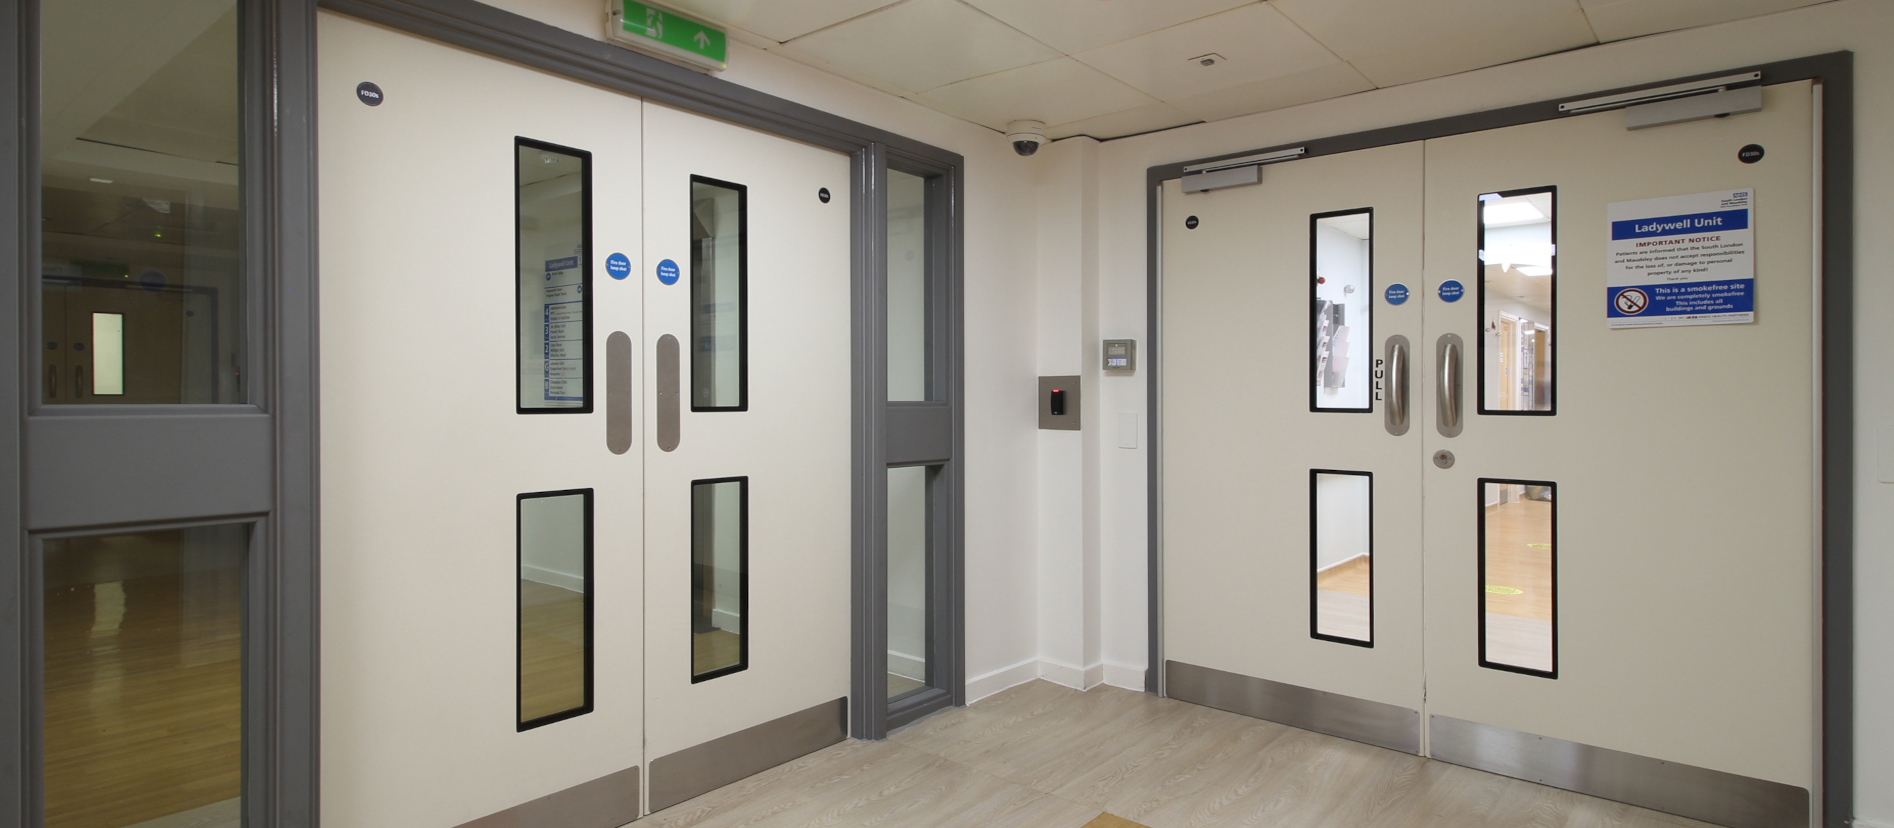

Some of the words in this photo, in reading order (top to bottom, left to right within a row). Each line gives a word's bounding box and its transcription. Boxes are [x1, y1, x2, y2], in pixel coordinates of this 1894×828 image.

[1635, 220, 1690, 233] Ladywell
[1695, 217, 1722, 227] Unit
[1636, 239, 1685, 247] IMPORTANT
[1687, 284, 1728, 292] smokefree
[1375, 359, 1383, 400] PULL
